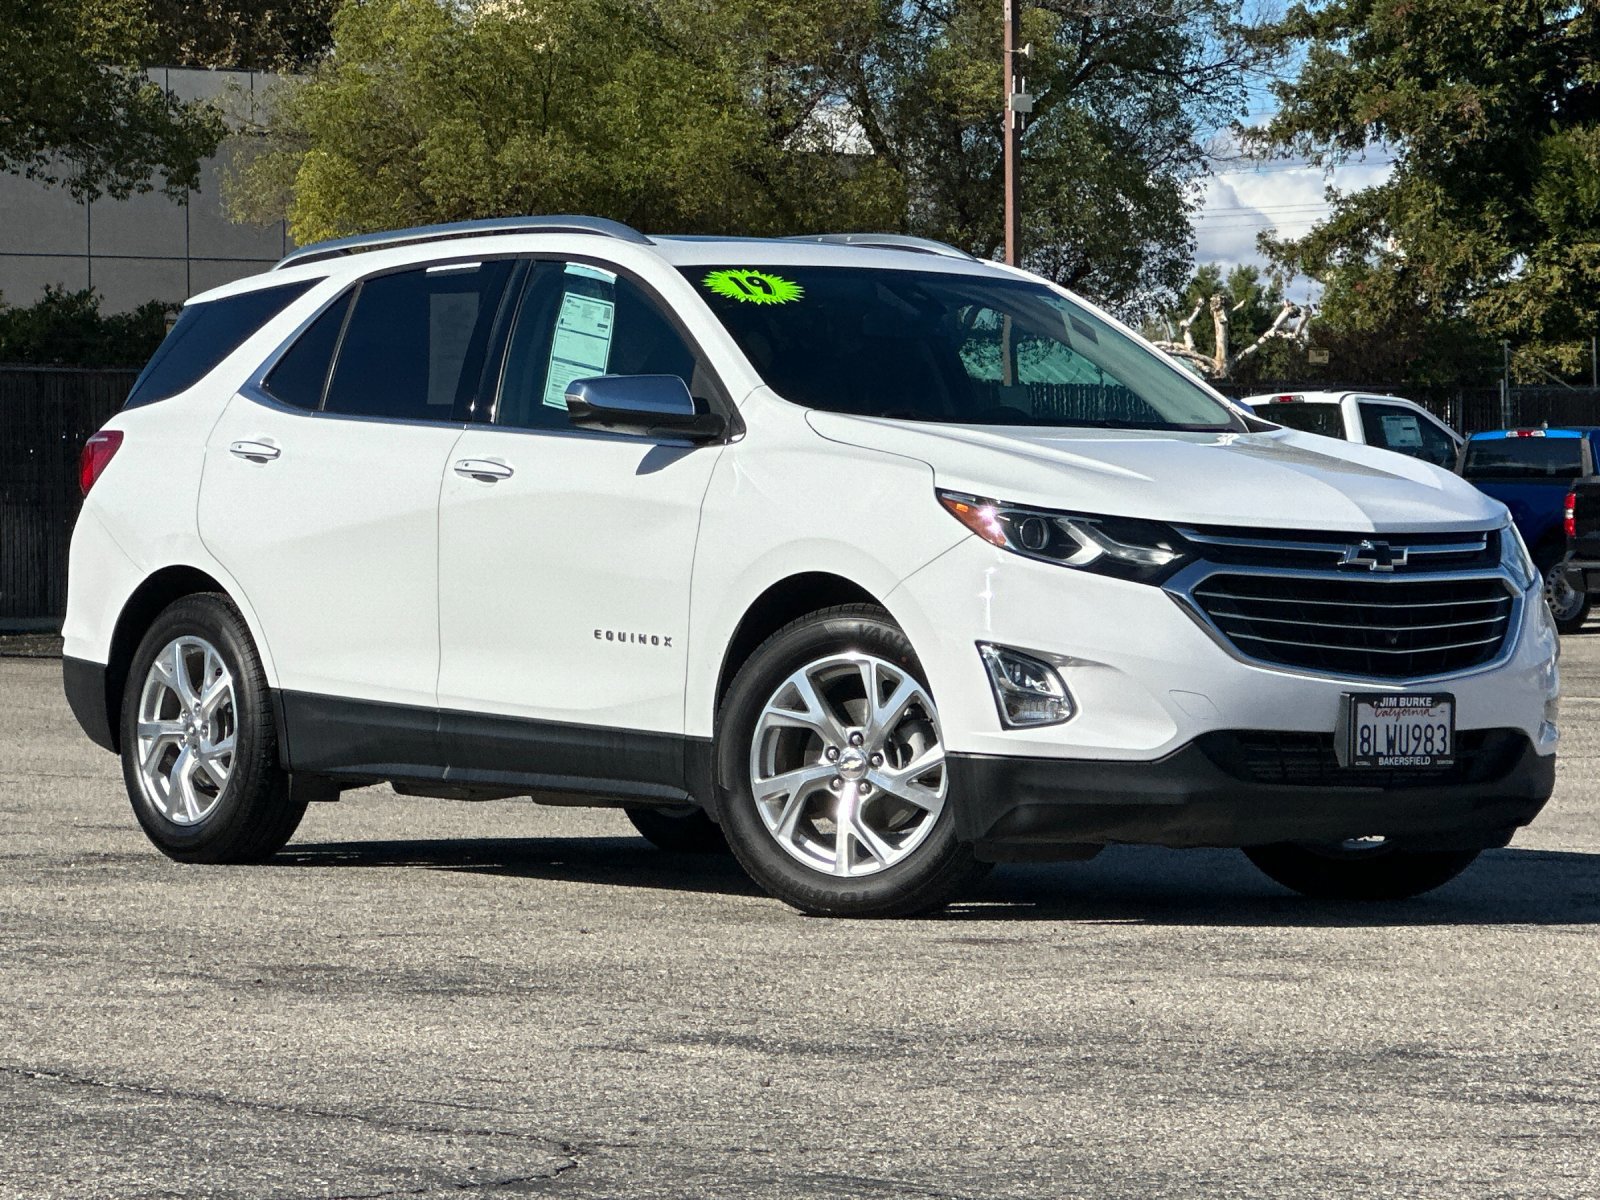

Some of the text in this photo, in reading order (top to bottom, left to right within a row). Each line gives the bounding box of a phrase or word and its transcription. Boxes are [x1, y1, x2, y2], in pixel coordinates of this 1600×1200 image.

[728, 276, 776, 296] 19
[594, 629, 672, 647] EQUINOX
[1380, 697, 1433, 707] JIM BURKE
[1360, 724, 1447, 756] 8LWU983
[1378, 756, 1431, 766] BAKERSFIELD
